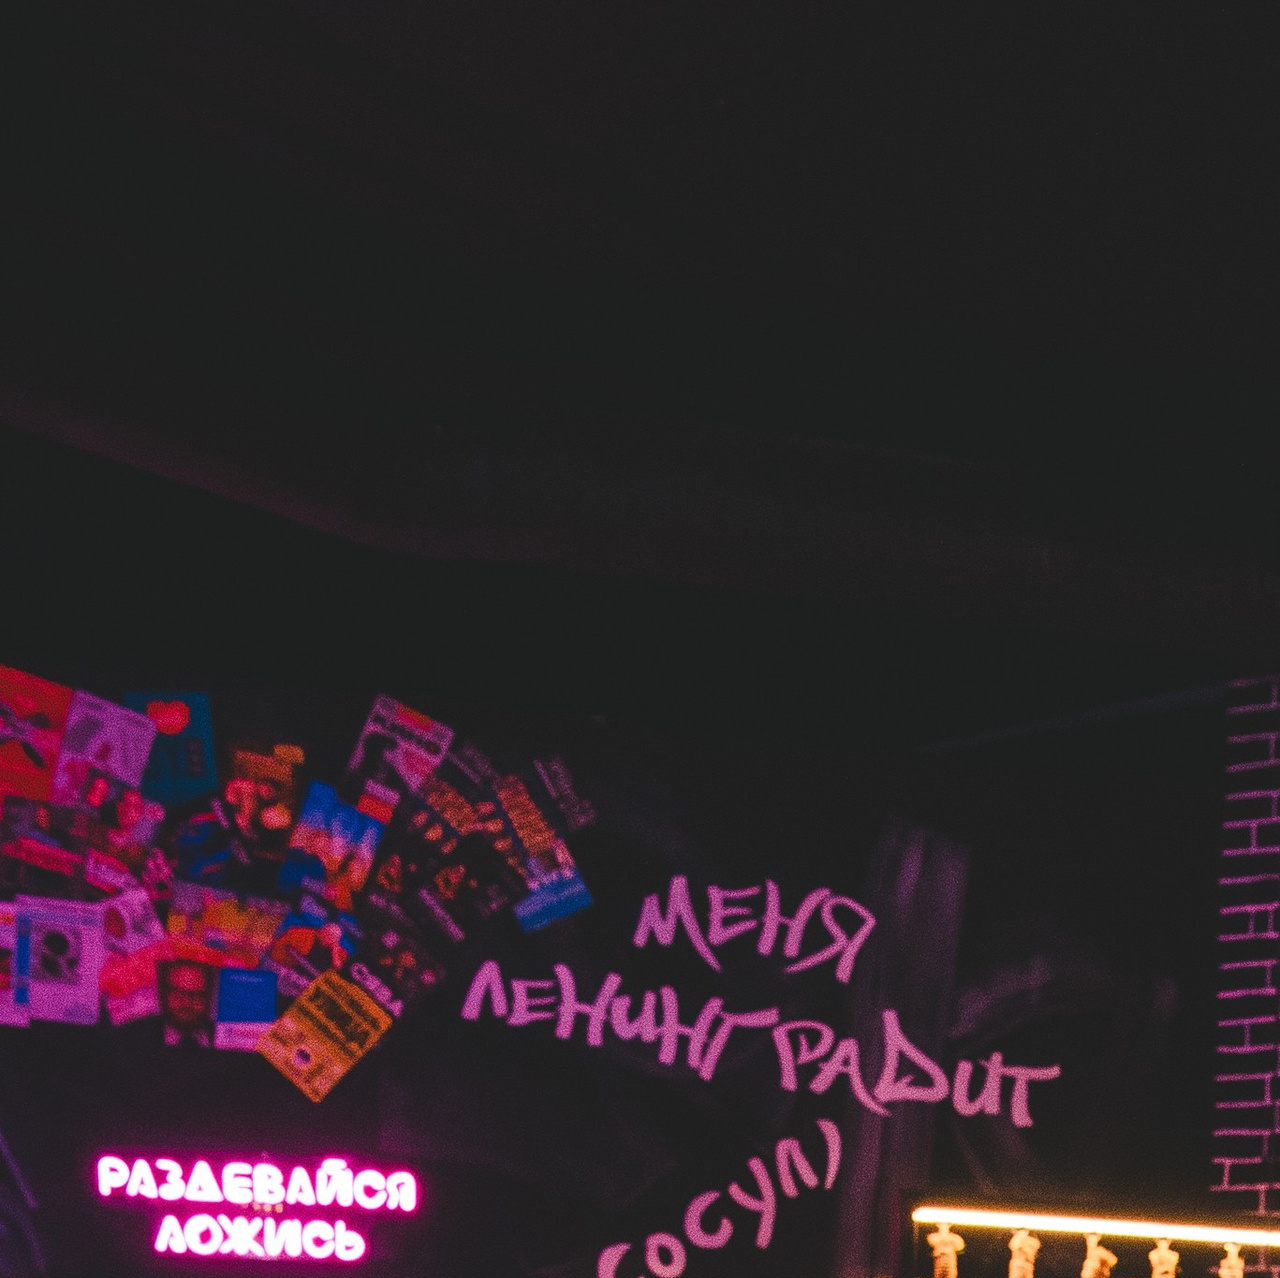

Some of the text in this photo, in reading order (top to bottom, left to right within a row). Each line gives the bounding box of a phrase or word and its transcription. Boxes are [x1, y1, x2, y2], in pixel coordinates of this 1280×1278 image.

[632, 874, 877, 983] МЕНЯ
[97, 1156, 418, 1212] РАЗДЕВАЙСЯ
[154, 1213, 366, 1262] ЛОЖИСЬ
